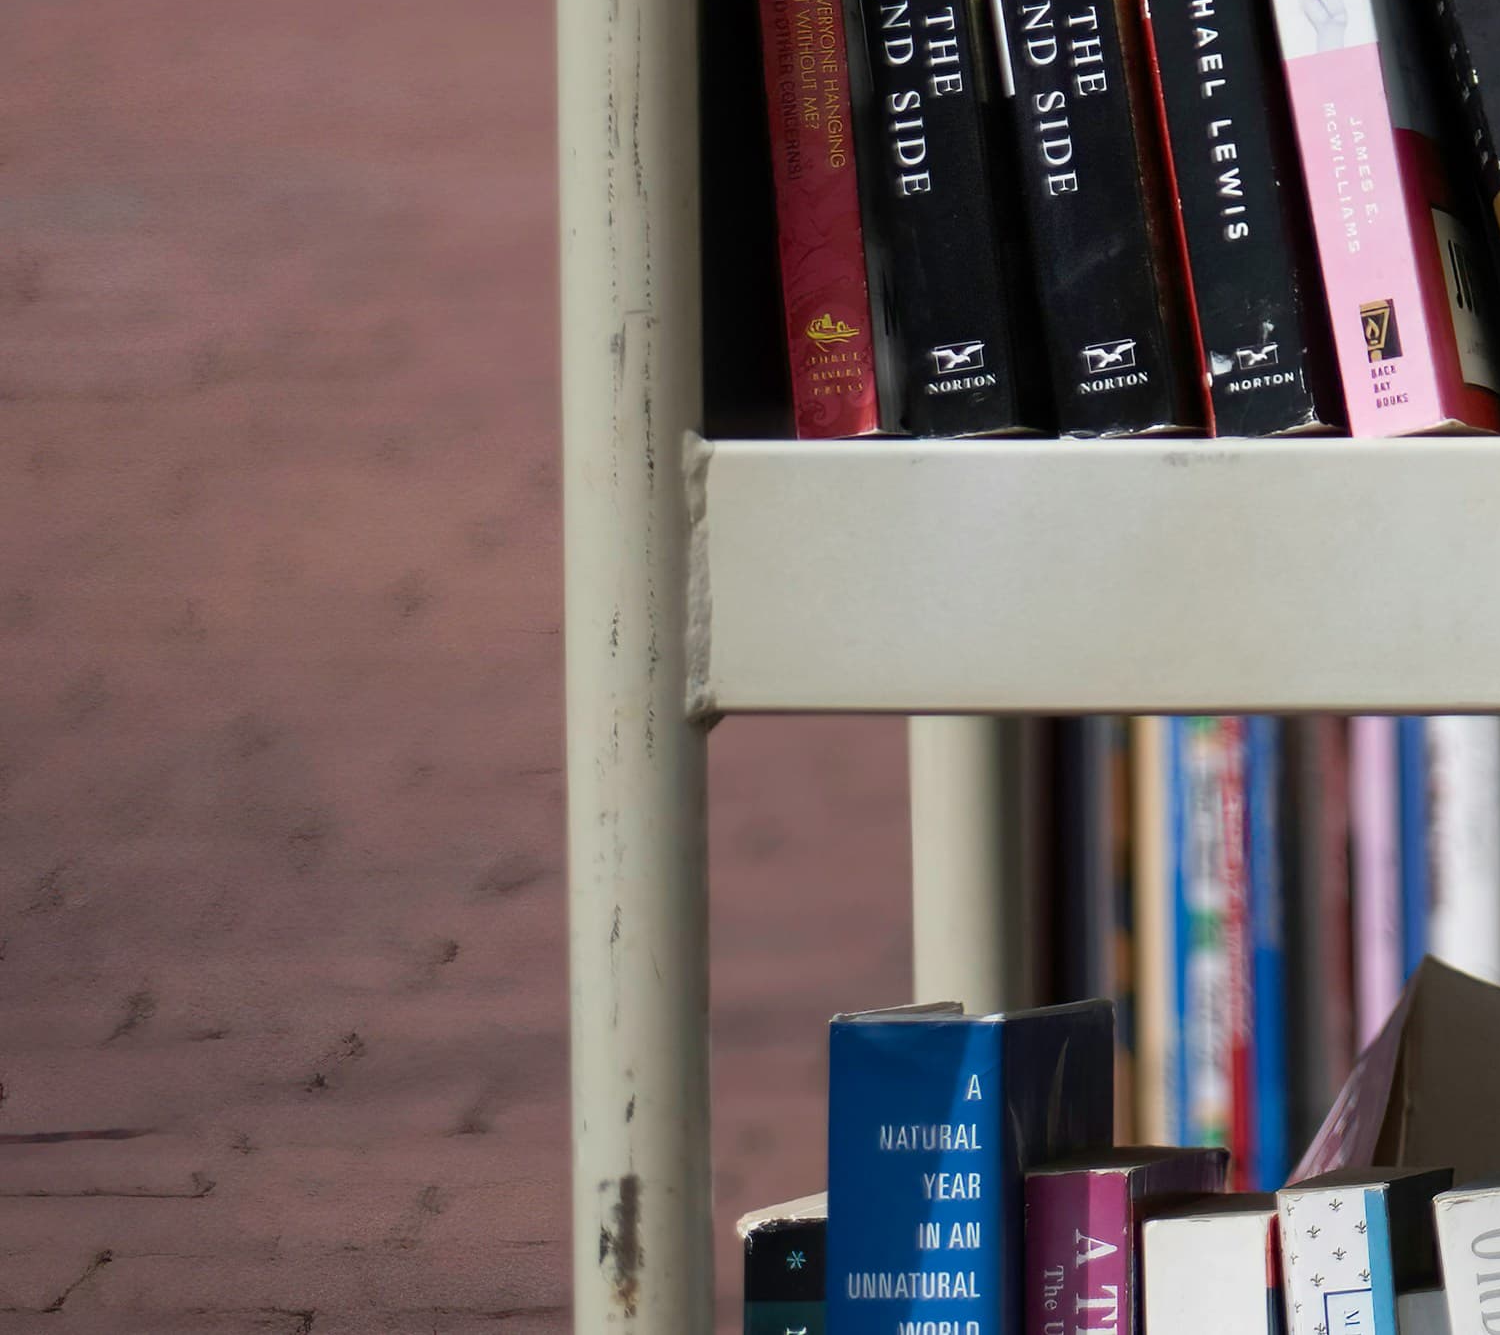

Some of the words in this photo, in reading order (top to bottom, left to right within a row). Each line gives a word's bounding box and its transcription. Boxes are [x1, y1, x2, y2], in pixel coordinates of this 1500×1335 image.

[924, 5, 964, 97] THE
[1067, 5, 1108, 97] THE
[890, 89, 932, 196] SIDE
[1034, 90, 1079, 197] SIDE
[1209, 118, 1250, 240] LEWIS
[927, 372, 999, 395] NORTON
[1079, 371, 1150, 395] NORTON
[1229, 371, 1296, 394] NORTON
[966, 1074, 983, 1101] A
[879, 1123, 983, 1151] NATURAL
[922, 1172, 982, 1200] YEAR
[918, 1221, 940, 1249] IN
[948, 1221, 981, 1249] AN
[847, 1271, 981, 1300] UNNATURAL
